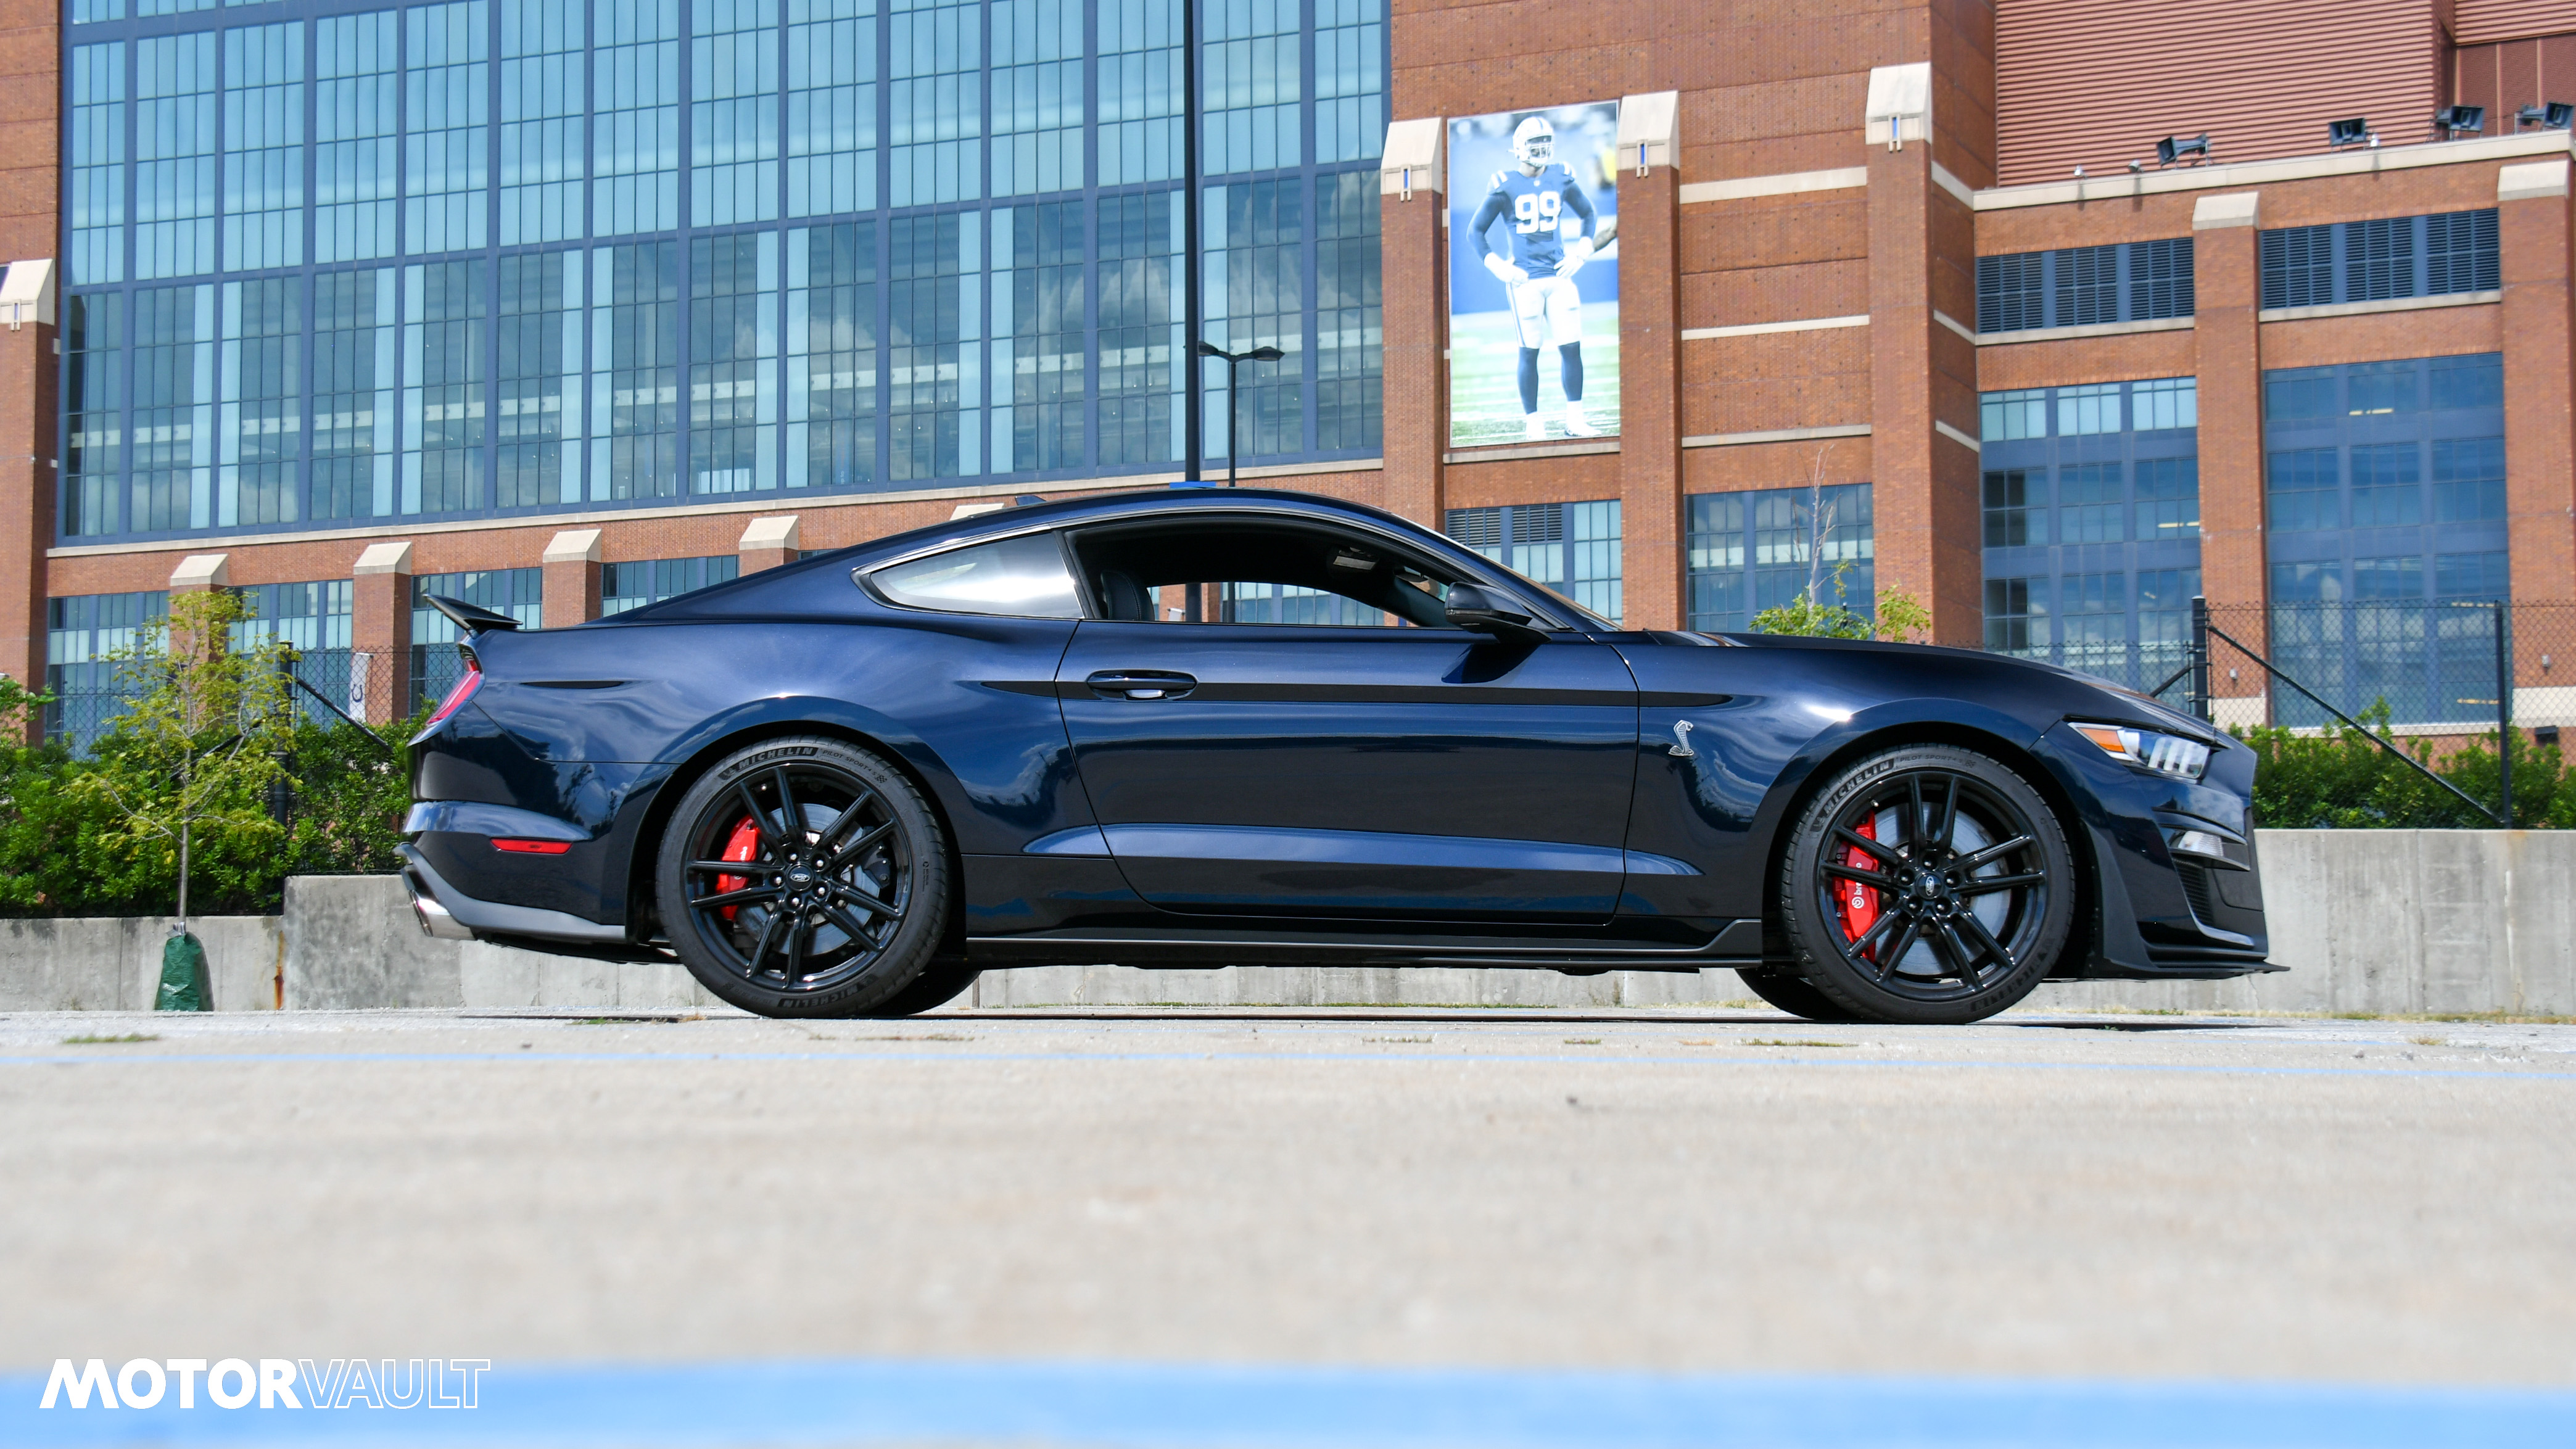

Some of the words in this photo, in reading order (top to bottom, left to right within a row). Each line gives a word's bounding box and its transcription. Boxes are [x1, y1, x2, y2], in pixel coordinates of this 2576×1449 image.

[1515, 191, 1561, 234] 99
[739, 747, 814, 770] MICHELIN
[822, 749, 843, 758] PILOT
[846, 756, 869, 769] SPORT
[1823, 761, 1889, 814] MICHELIN
[1853, 862, 1862, 896] breo
